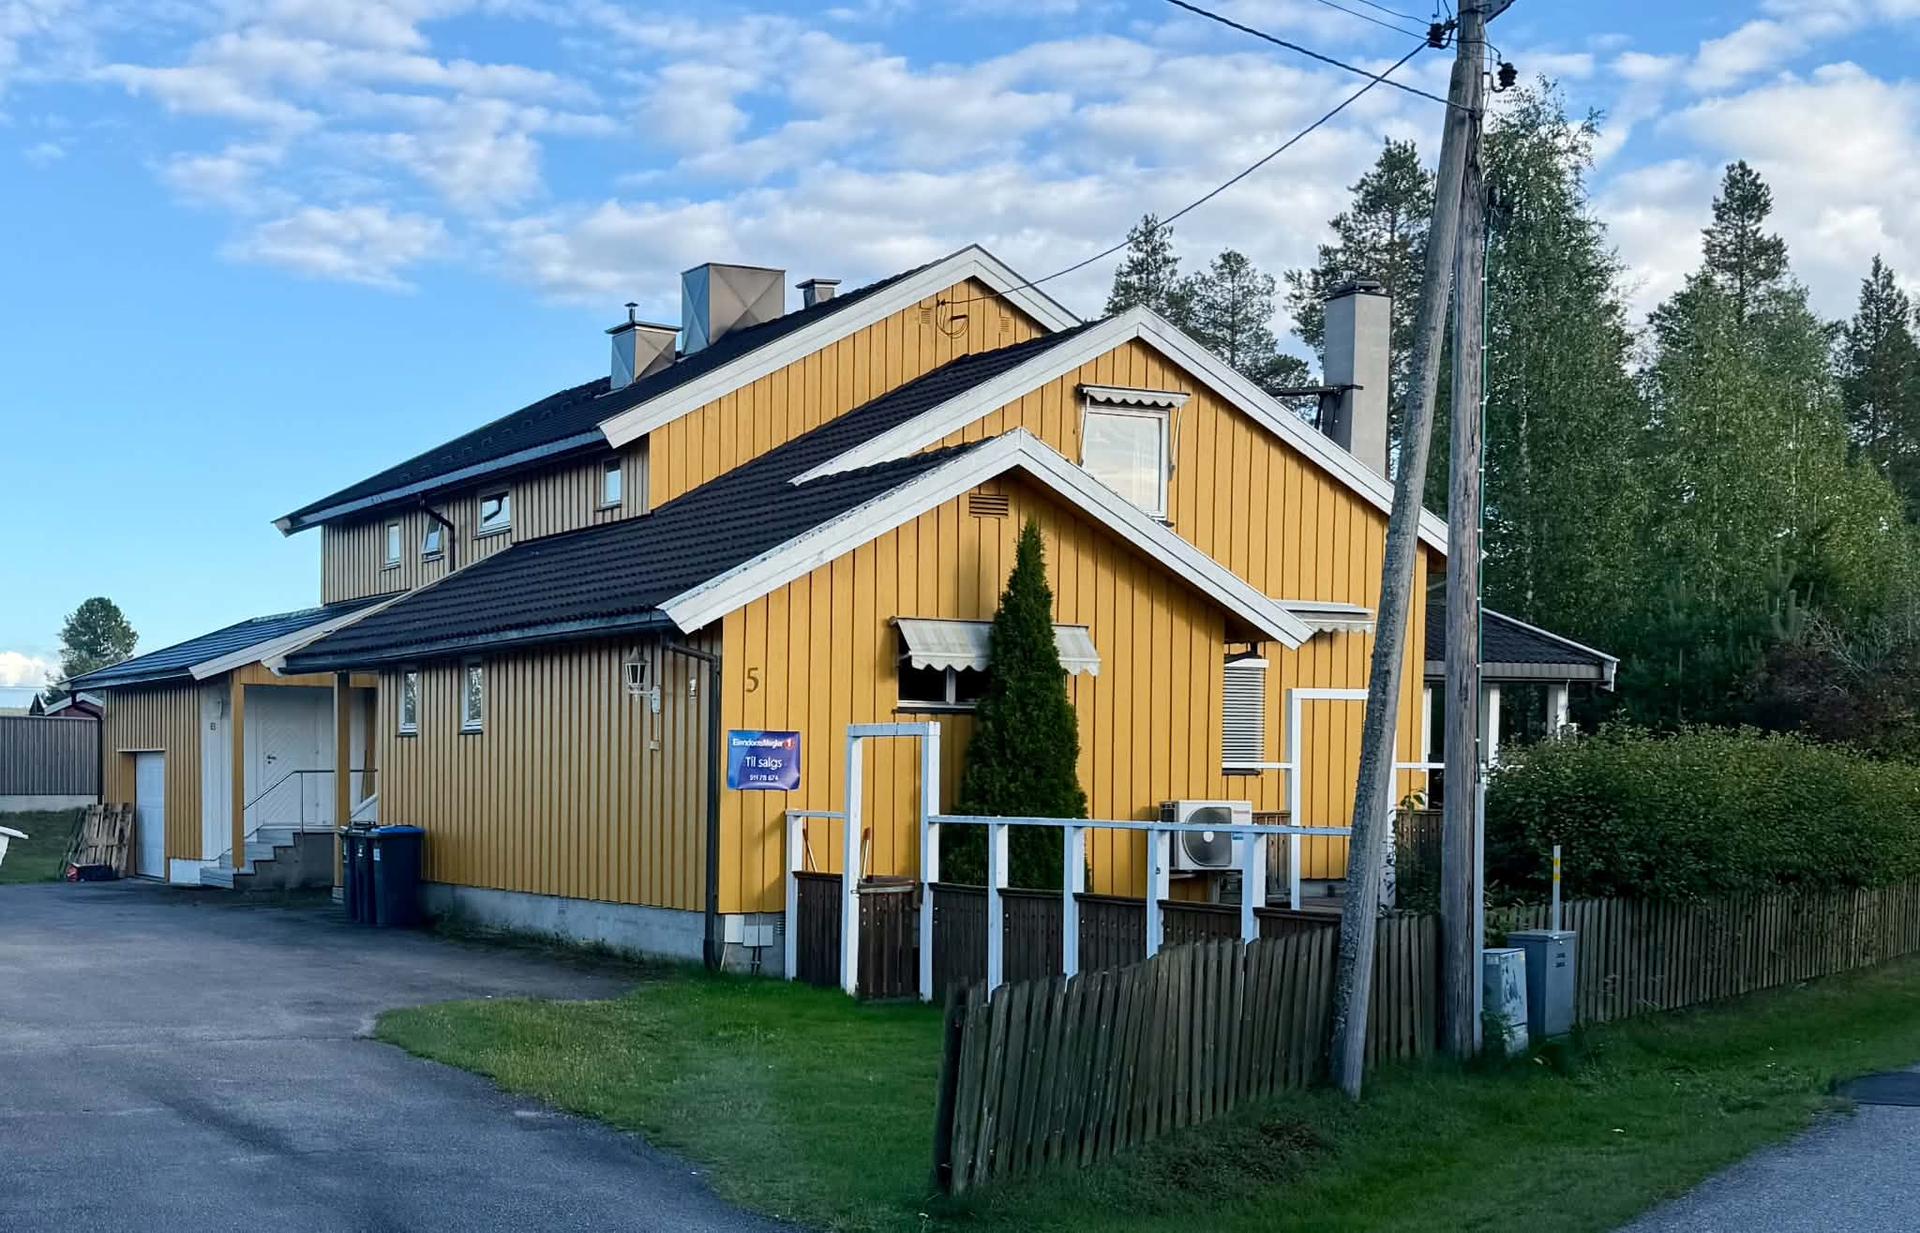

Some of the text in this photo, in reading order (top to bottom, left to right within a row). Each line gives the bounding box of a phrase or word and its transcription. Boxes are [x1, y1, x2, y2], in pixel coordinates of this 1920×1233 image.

[746, 667, 759, 693] 5
[745, 756, 783, 770] Til salgs
